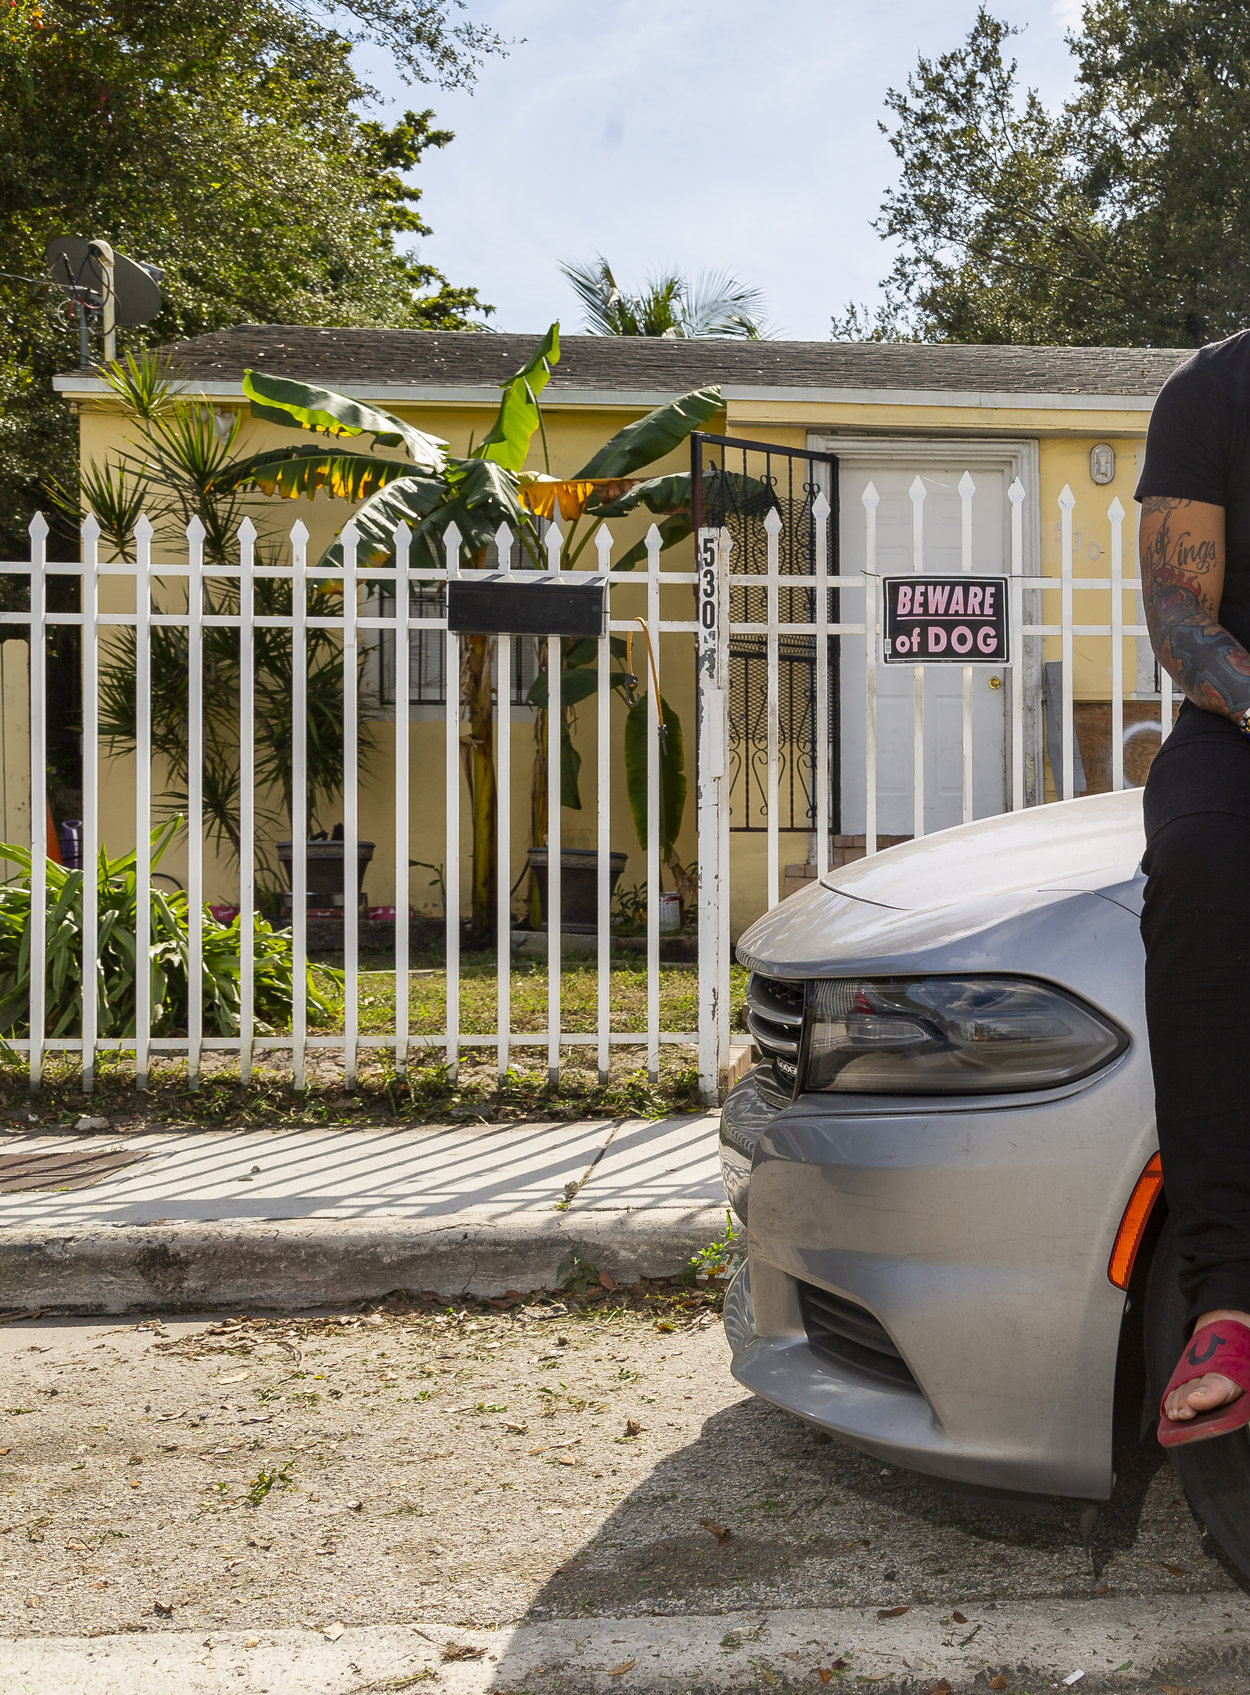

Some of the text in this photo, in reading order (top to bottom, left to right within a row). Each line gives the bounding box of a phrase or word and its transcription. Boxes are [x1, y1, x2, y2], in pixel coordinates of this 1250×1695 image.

[702, 538, 715, 629] 530
[896, 585, 996, 615] BEWARE
[895, 625, 998, 654] of DOG
